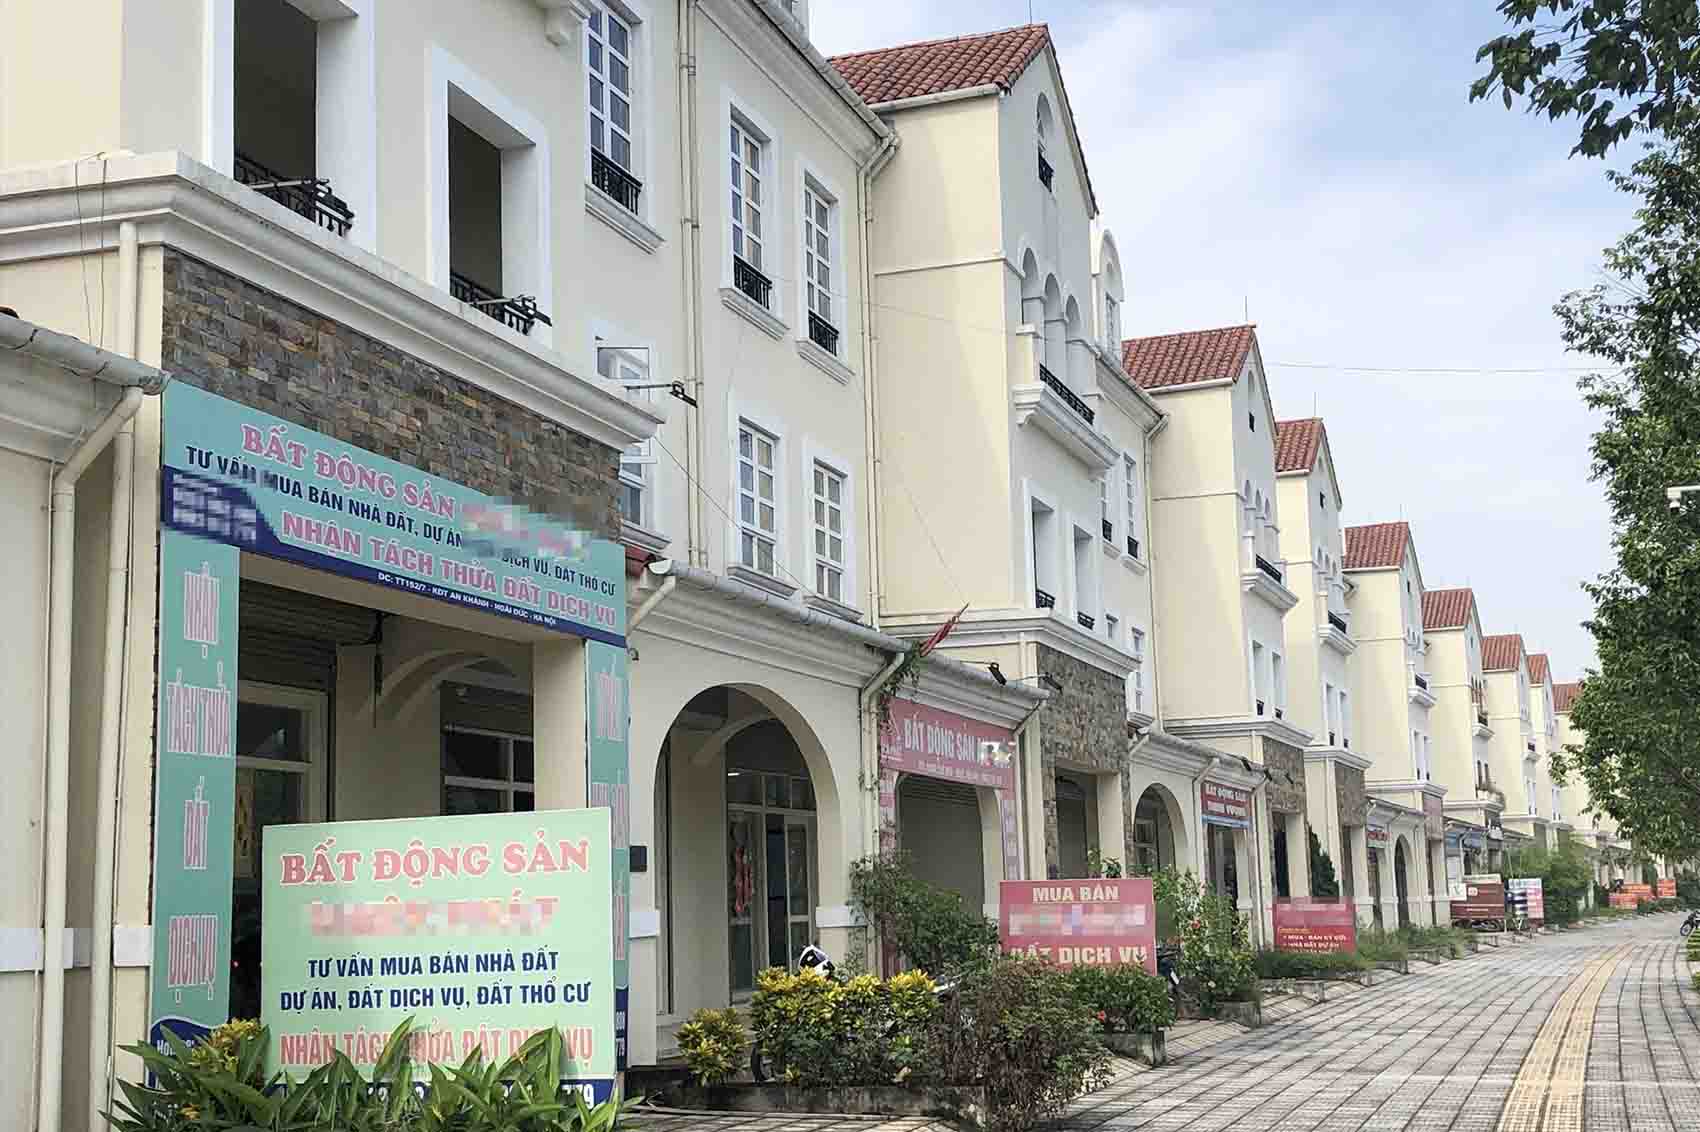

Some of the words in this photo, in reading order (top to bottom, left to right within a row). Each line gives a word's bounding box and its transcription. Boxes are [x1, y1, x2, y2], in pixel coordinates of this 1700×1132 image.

[185, 445, 214, 469] TƯ
[348, 498, 382, 525] NHÀ
[240, 423, 308, 470] BẤT
[314, 450, 397, 500] ĐỘNG
[403, 481, 456, 521] SẢN
[282, 510, 362, 557] NHẬN
[368, 535, 433, 577] TÁCH
[441, 557, 498, 594] THỬA
[503, 574, 542, 606] ĐẤT
[903, 711, 926, 753] BẤT
[927, 720, 955, 761] ĐỘNG
[280, 837, 363, 886] BẤT
[372, 838, 493, 888] ĐỘNG
[503, 827, 591, 875] SẢN
[1032, 886, 1074, 902] MUA
[1079, 883, 1119, 902] BÁN
[308, 957, 333, 978] TƯ
[336, 951, 374, 978] VẤN
[380, 956, 424, 976] MUA
[429, 950, 470, 974] BÁN
[475, 948, 516, 973] NHÀ
[521, 944, 559, 972] ĐẤT
[280, 989, 308, 1015] DỰ
[311, 987, 343, 1011] ÁN,
[348, 983, 384, 1009] ĐẤT
[389, 987, 434, 1012] DỊCH
[440, 985, 471, 1011] VỤ,
[476, 977, 513, 1006] ĐẤT
[519, 975, 557, 1005] THỔ
[562, 981, 592, 1004] CƯ
